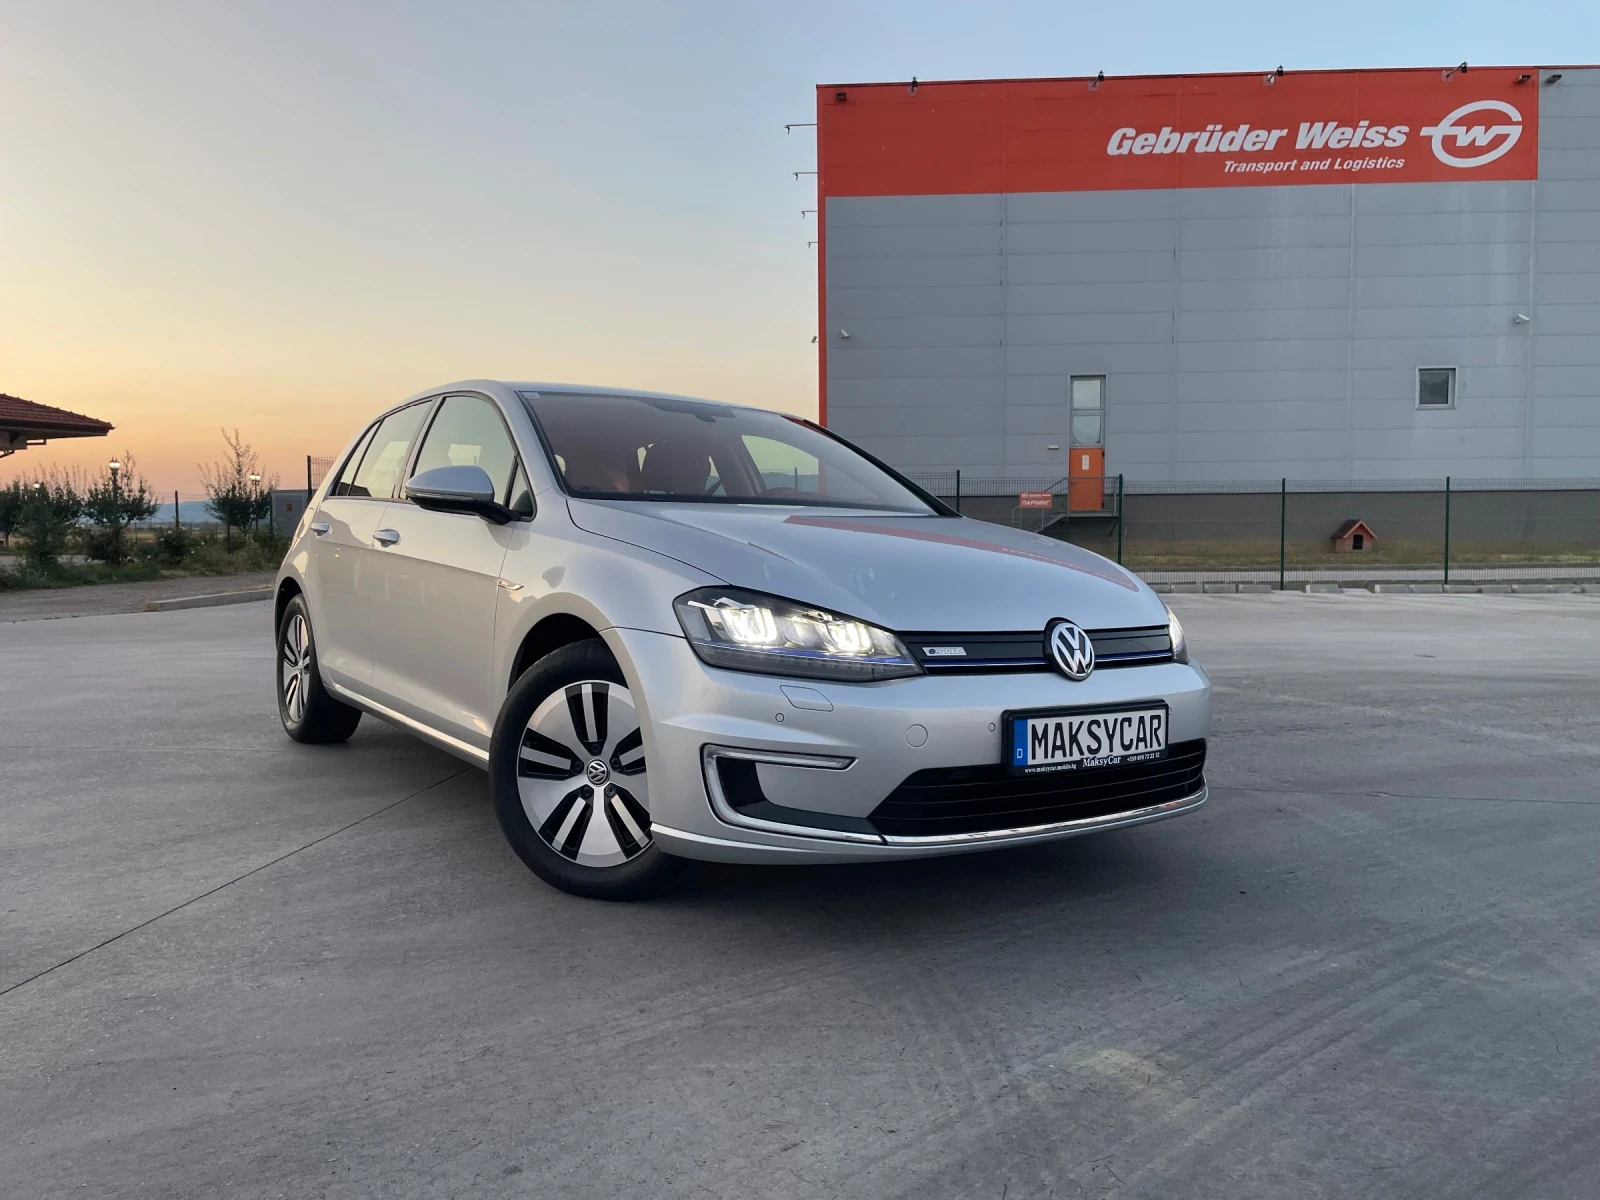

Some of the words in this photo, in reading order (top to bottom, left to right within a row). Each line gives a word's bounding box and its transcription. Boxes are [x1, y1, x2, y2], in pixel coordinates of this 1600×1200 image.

[1107, 124, 1287, 156] Gebrüder
[1295, 120, 1409, 149] Weiss
[1224, 159, 1297, 174] Transport
[1300, 158, 1330, 170] and
[1334, 157, 1404, 172] Logistics
[1031, 714, 1162, 760] MAKSYCAR
[1016, 748, 1023, 759] D
[1082, 756, 1121, 767] MaksyCar
